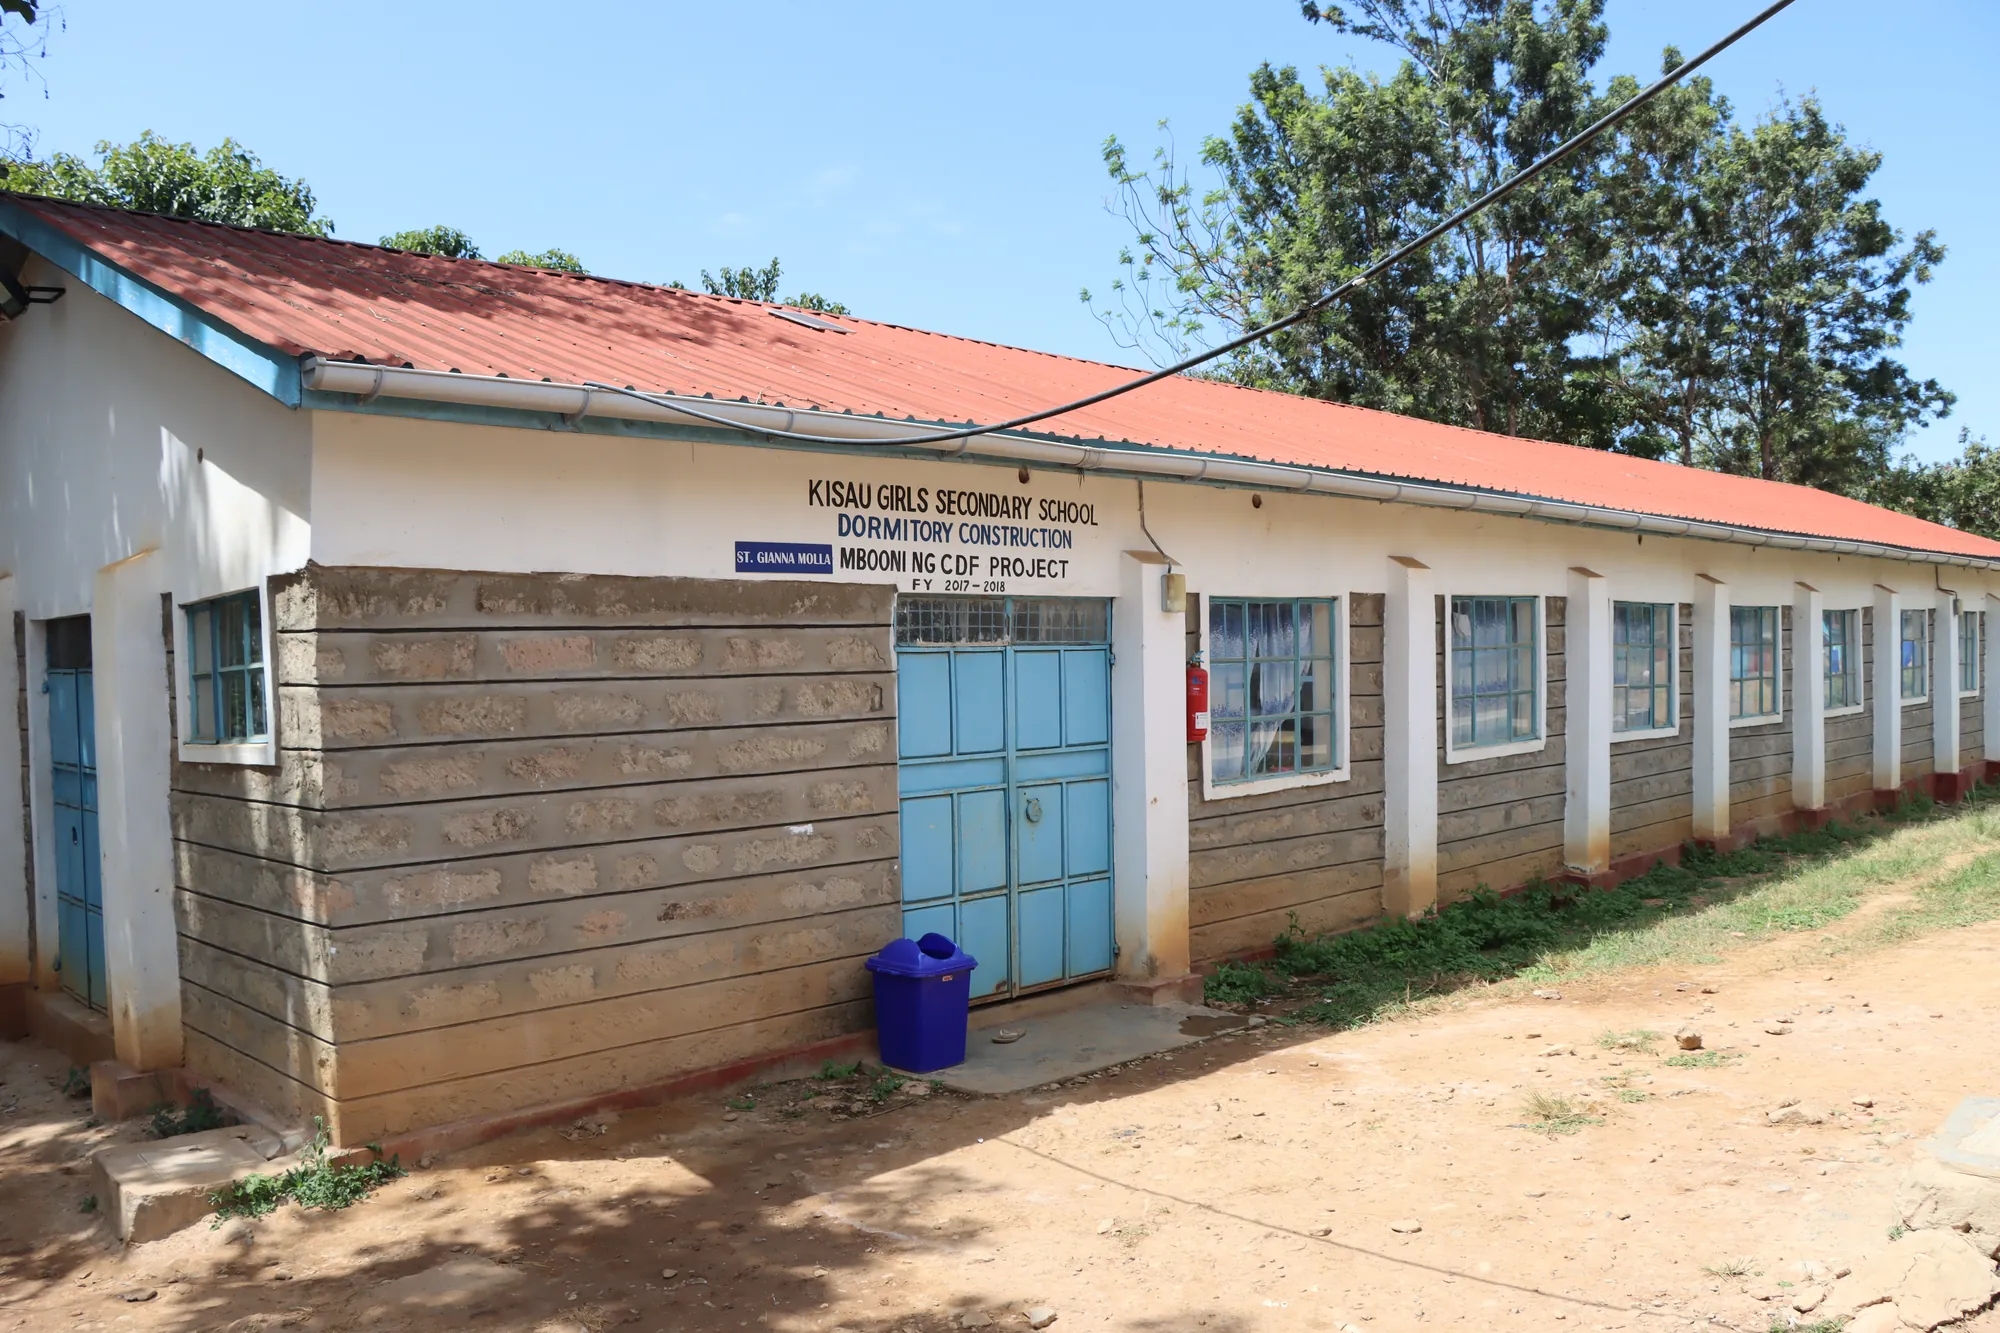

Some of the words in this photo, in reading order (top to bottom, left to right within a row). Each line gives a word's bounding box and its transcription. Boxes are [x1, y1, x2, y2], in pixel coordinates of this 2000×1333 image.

[808, 479, 872, 509] KISAU
[877, 484, 929, 513] GIRLS
[935, 489, 1033, 520] SECONDARY
[1038, 498, 1099, 526] SCHOOL
[837, 513, 954, 543] DORMITORY
[958, 522, 1072, 549] CONSTRUCTION
[736, 550, 753, 564] ST.
[756, 551, 795, 565] GIANNA
[797, 552, 831, 565] MOLLA
[940, 553, 980, 576] CDF
[989, 556, 1069, 579] PROJECT
[944, 579, 970, 592] 2017
[983, 580, 1006, 592] 2018
